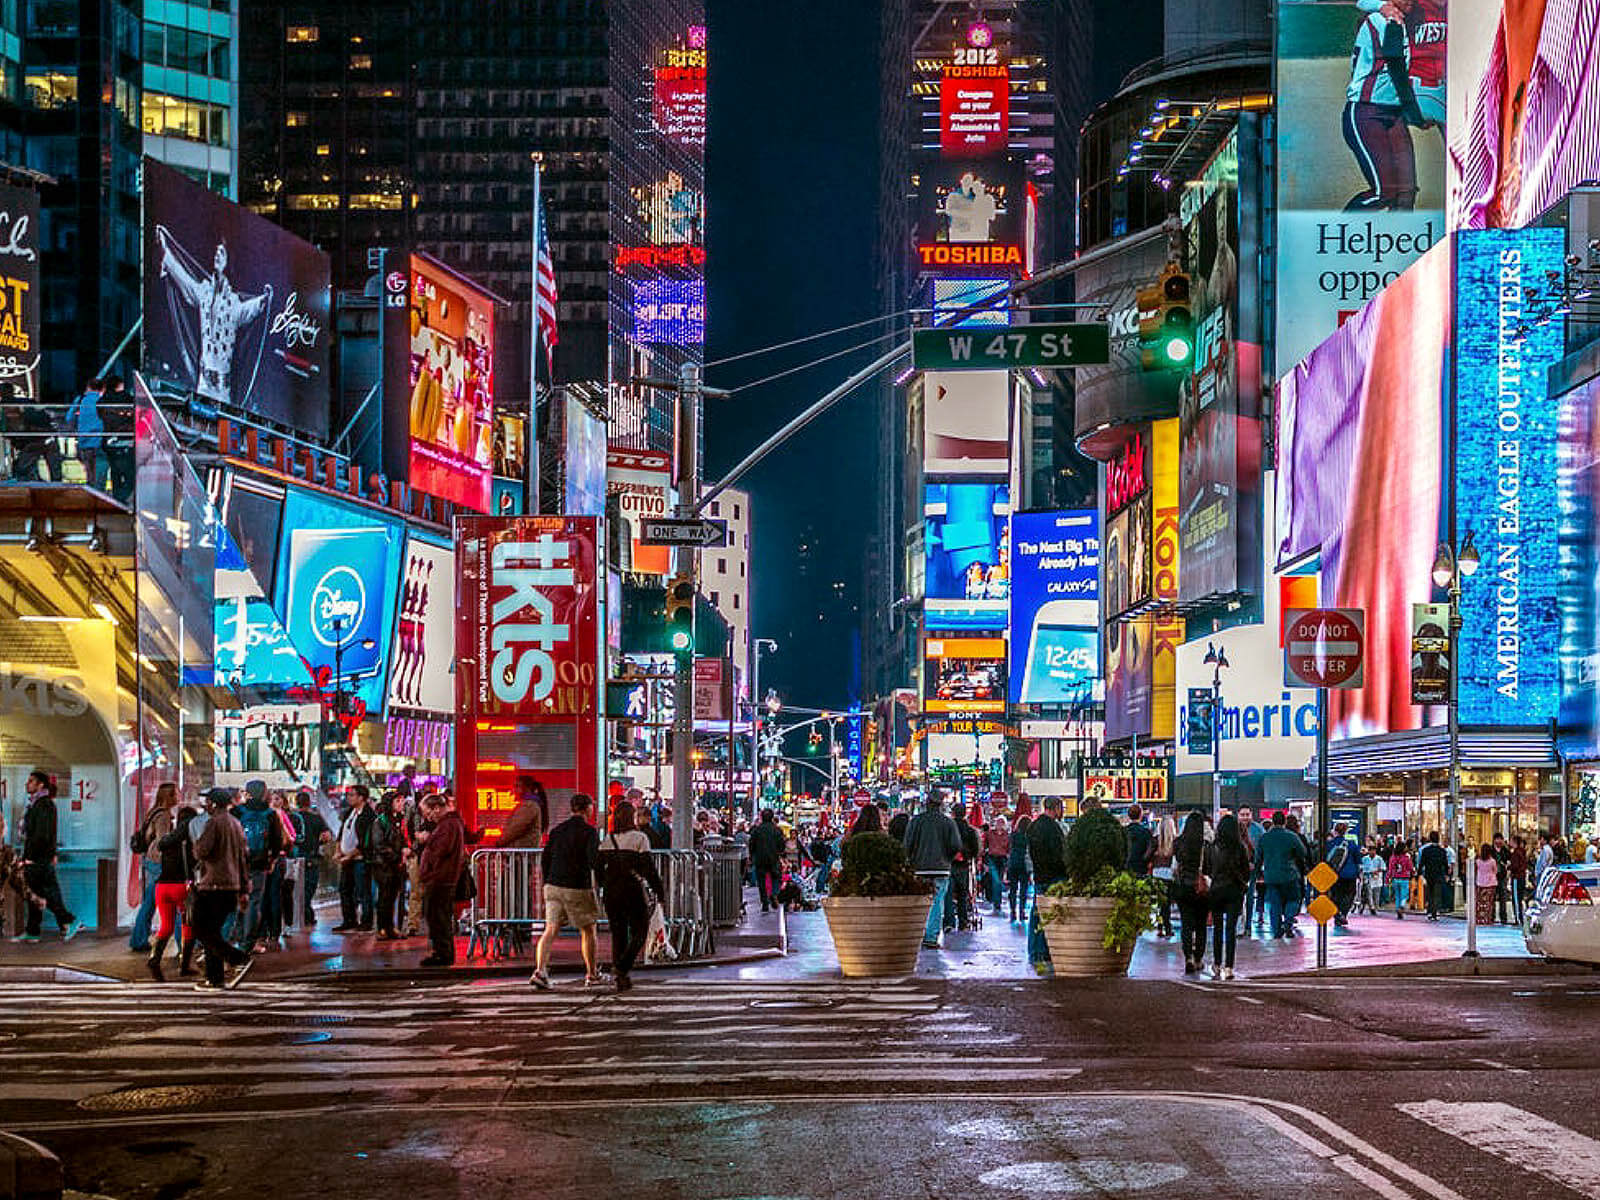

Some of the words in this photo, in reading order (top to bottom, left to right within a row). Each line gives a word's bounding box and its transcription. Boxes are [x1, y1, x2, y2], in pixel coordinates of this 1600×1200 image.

[954, 49, 997, 64] 2012
[943, 66, 1008, 77] TOSHIBA
[1316, 222, 1433, 263] Helped
[920, 247, 1022, 264] TOSHIBA
[387, 294, 405, 307] LG
[949, 335, 973, 361] W
[985, 334, 1027, 359] 47
[1040, 332, 1072, 358] St
[1499, 249, 1522, 431] OUTFITTERS
[608, 480, 664, 497] EXPERIENCE
[1498, 440, 1520, 534] EAGLE
[653, 527, 678, 537] ONE
[688, 528, 714, 538] WAY
[1018, 542, 1038, 555] The
[1039, 541, 1064, 554] Next
[1065, 539, 1083, 554] Big
[1039, 555, 1077, 570] Already
[318, 587, 358, 625] Disney
[479, 592, 488, 624] Theatre
[492, 534, 574, 703] tkts
[1497, 545, 1518, 700] AMERICAN
[1300, 624, 1318, 638] DO
[1324, 624, 1350, 638] NOT
[478, 625, 488, 680] Development
[1046, 645, 1089, 669] 12:45
[1303, 660, 1347, 673] ENER
[479, 681, 488, 703] Fund
[949, 711, 982, 719] SONY
[1218, 691, 1319, 740] meric
[385, 716, 451, 759] FOREVER
[1083, 758, 1169, 767] MARQUIS
[75, 779, 98, 800] 12
